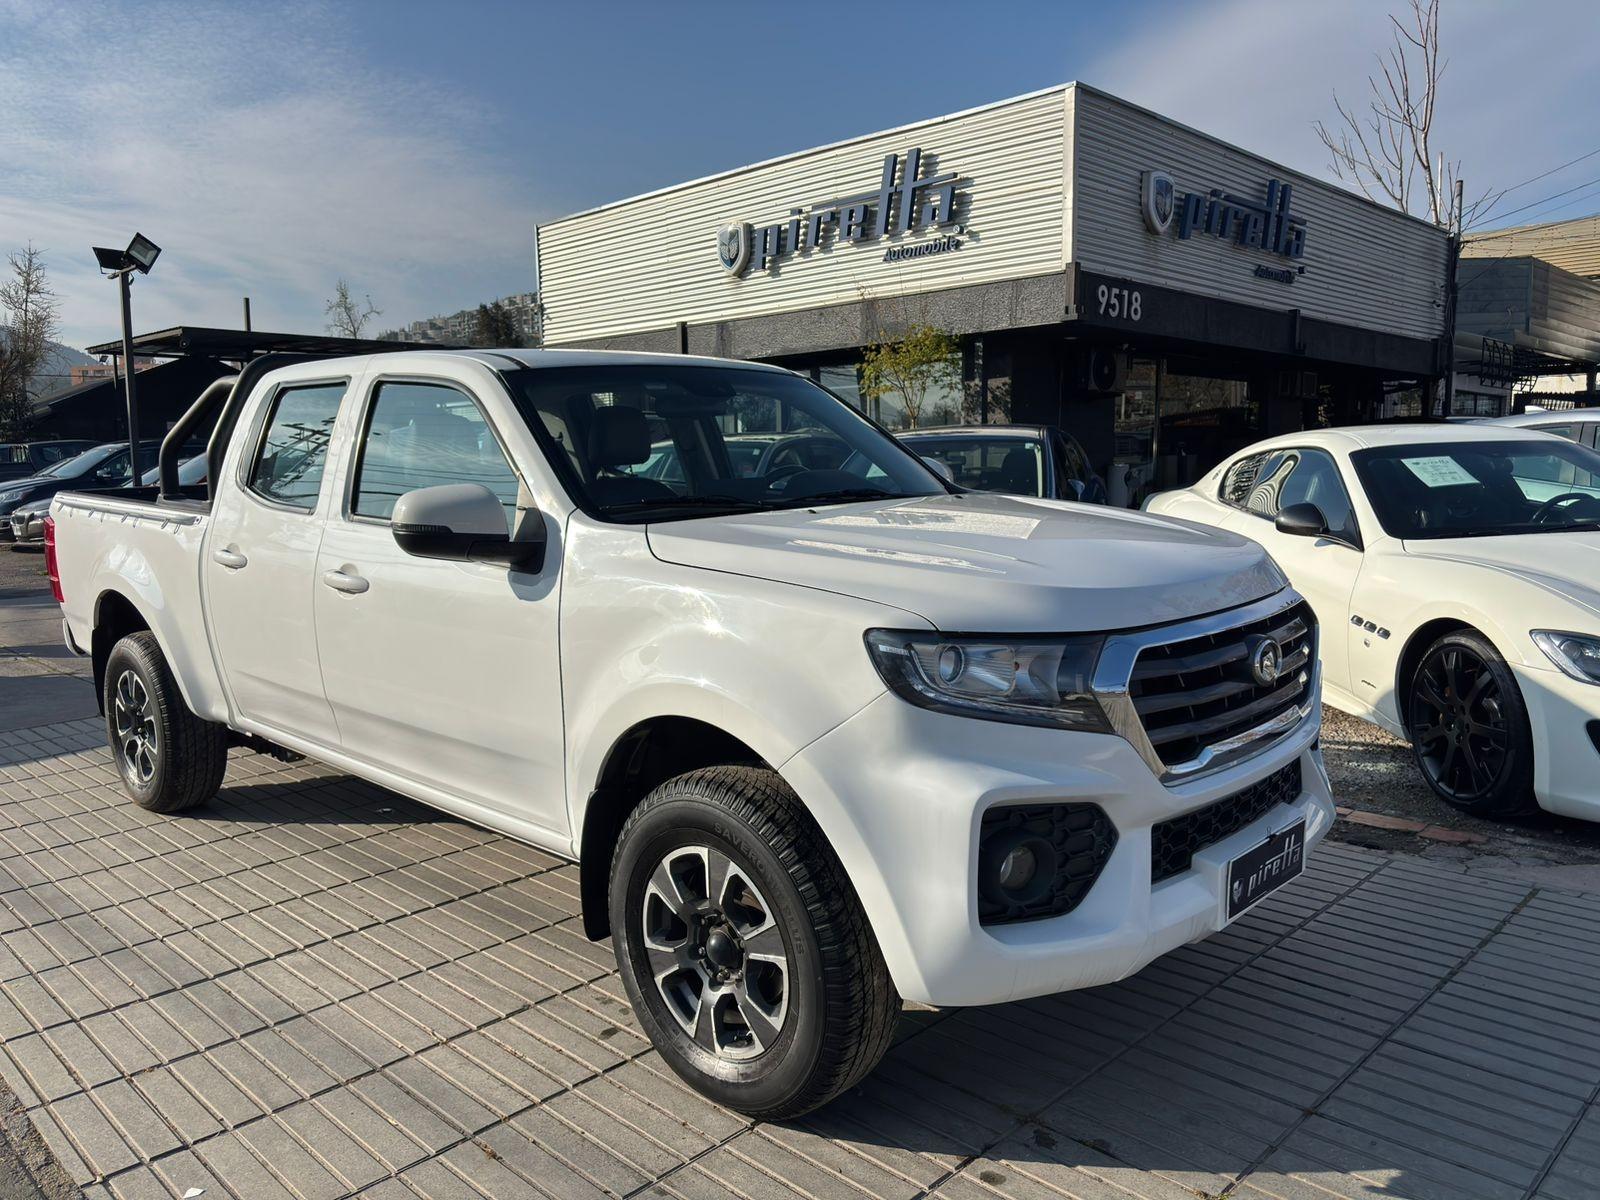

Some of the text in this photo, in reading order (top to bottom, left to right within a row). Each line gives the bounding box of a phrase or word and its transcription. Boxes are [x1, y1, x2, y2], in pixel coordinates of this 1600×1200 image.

[752, 147, 959, 270] piretta
[1178, 178, 1308, 260] piretta
[882, 234, 961, 263] Automobile
[1097, 284, 1143, 322] 9518
[713, 821, 766, 874] SAVERO
[1247, 833, 1302, 898] piretta
